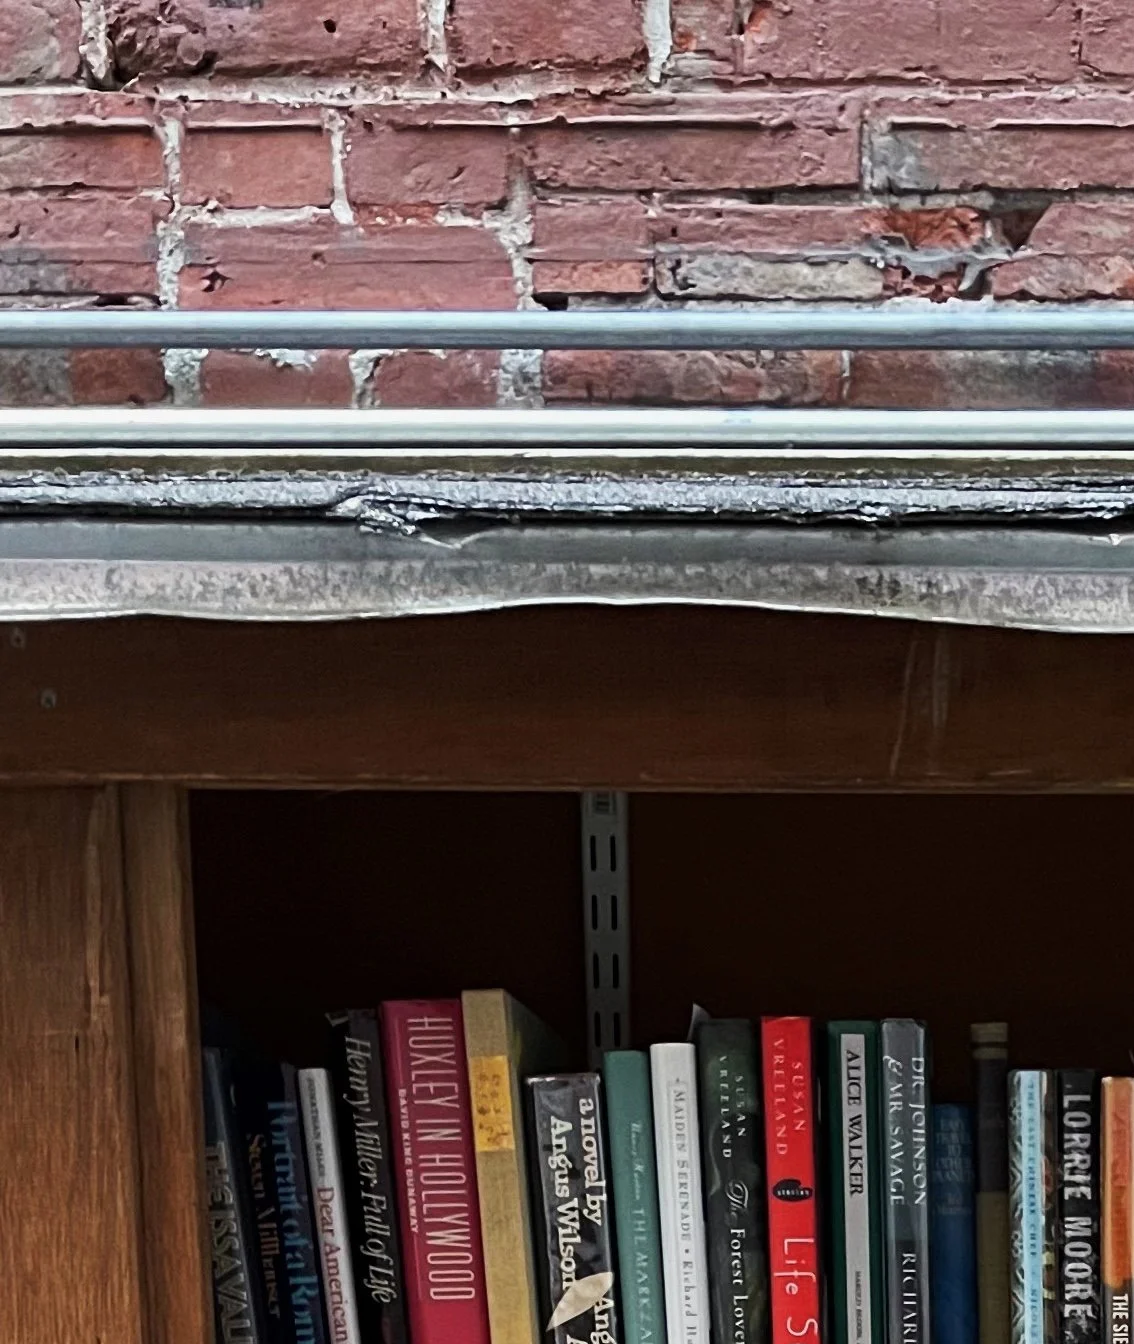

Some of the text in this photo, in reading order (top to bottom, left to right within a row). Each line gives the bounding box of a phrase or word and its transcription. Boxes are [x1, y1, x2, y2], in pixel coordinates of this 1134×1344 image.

[343, 1037, 396, 1303] Henry Miller: Full of Life
[407, 1017, 475, 1301] HUXLEY IN HOLLYWOOD
[578, 1098, 605, 1225] a novel by
[847, 1049, 864, 1197] ALICE WALKER
[1063, 1094, 1092, 1200] LORRIE
[549, 1116, 581, 1287] Angus Wilson
[1064, 1217, 1093, 1317] MOORE
